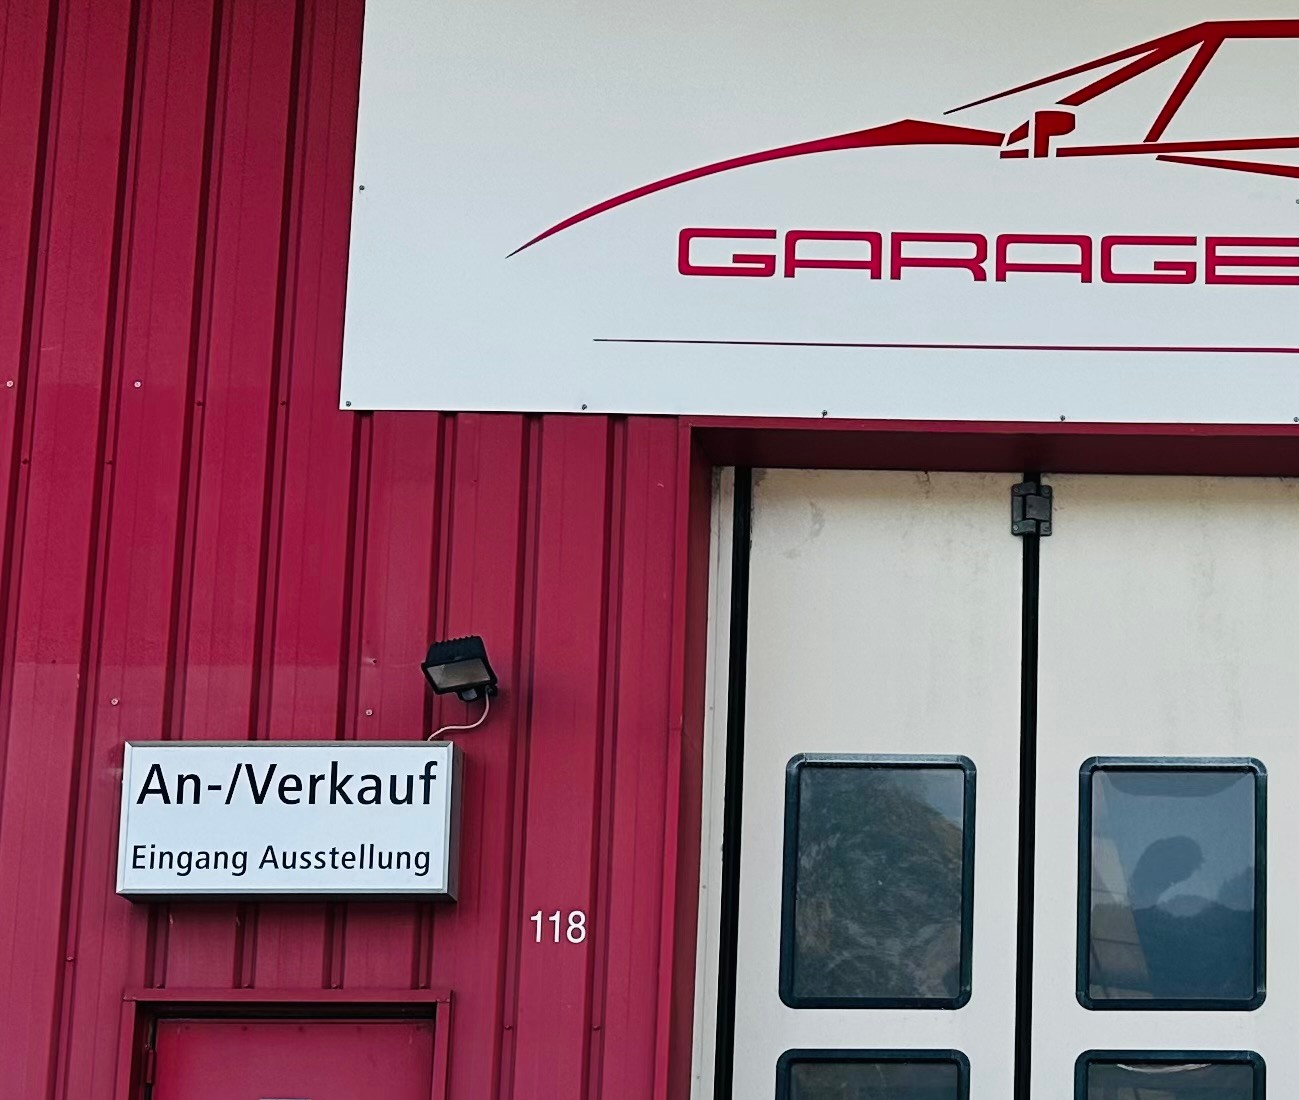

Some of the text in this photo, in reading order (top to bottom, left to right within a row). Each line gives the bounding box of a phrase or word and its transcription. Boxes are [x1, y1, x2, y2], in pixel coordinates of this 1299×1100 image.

[136, 760, 438, 805] An-/Verkauf
[132, 843, 430, 877] Eingang Ausstellung
[530, 910, 586, 944] 118
